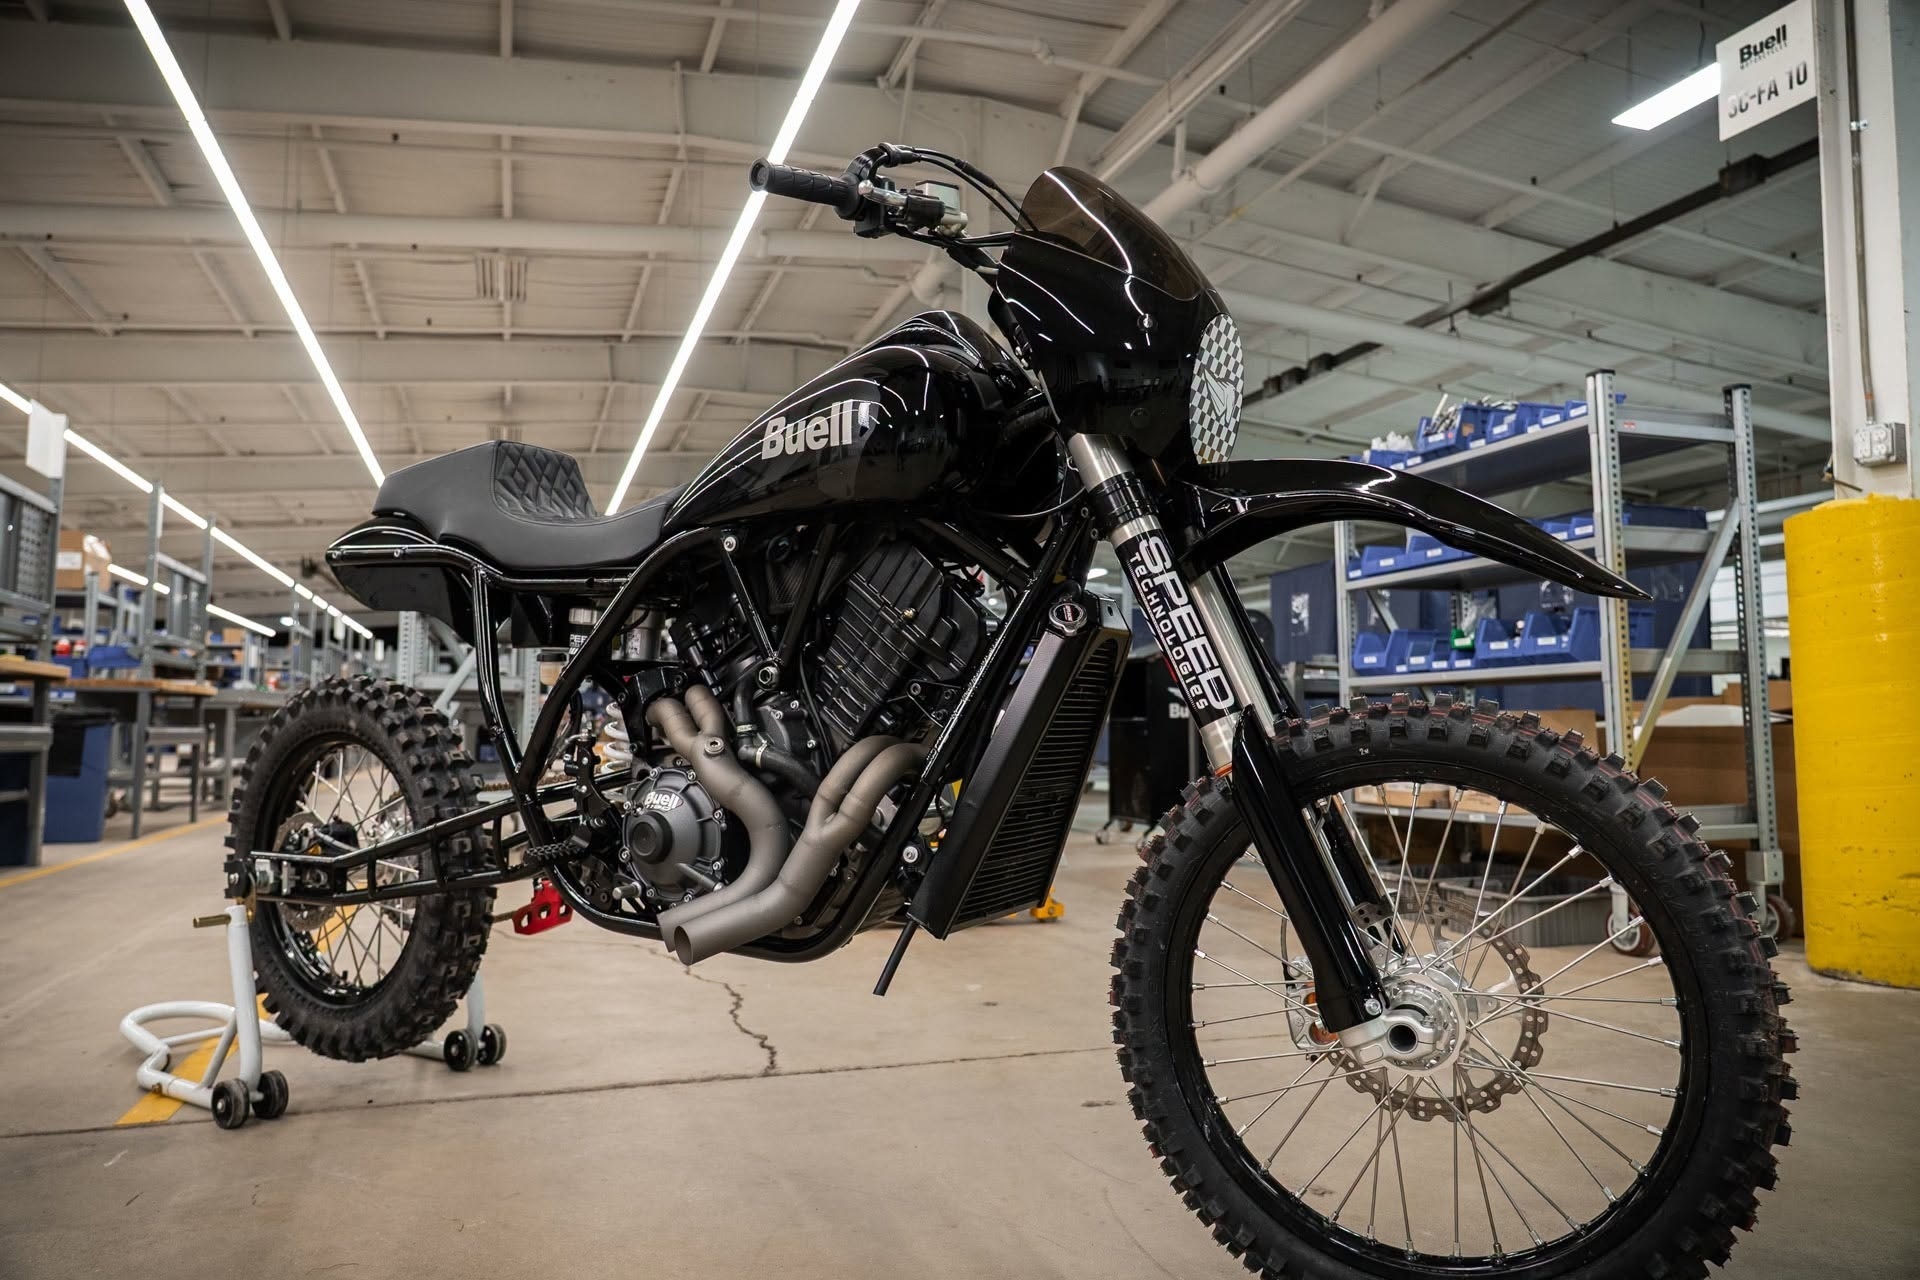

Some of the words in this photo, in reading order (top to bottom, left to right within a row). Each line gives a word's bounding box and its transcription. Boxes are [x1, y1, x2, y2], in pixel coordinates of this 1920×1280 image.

[1739, 24, 1786, 64] Buell
[1785, 60, 1807, 89] 10
[762, 400, 852, 459] Buell
[1139, 536, 1235, 710] SPEED
[645, 791, 680, 809] Buell
